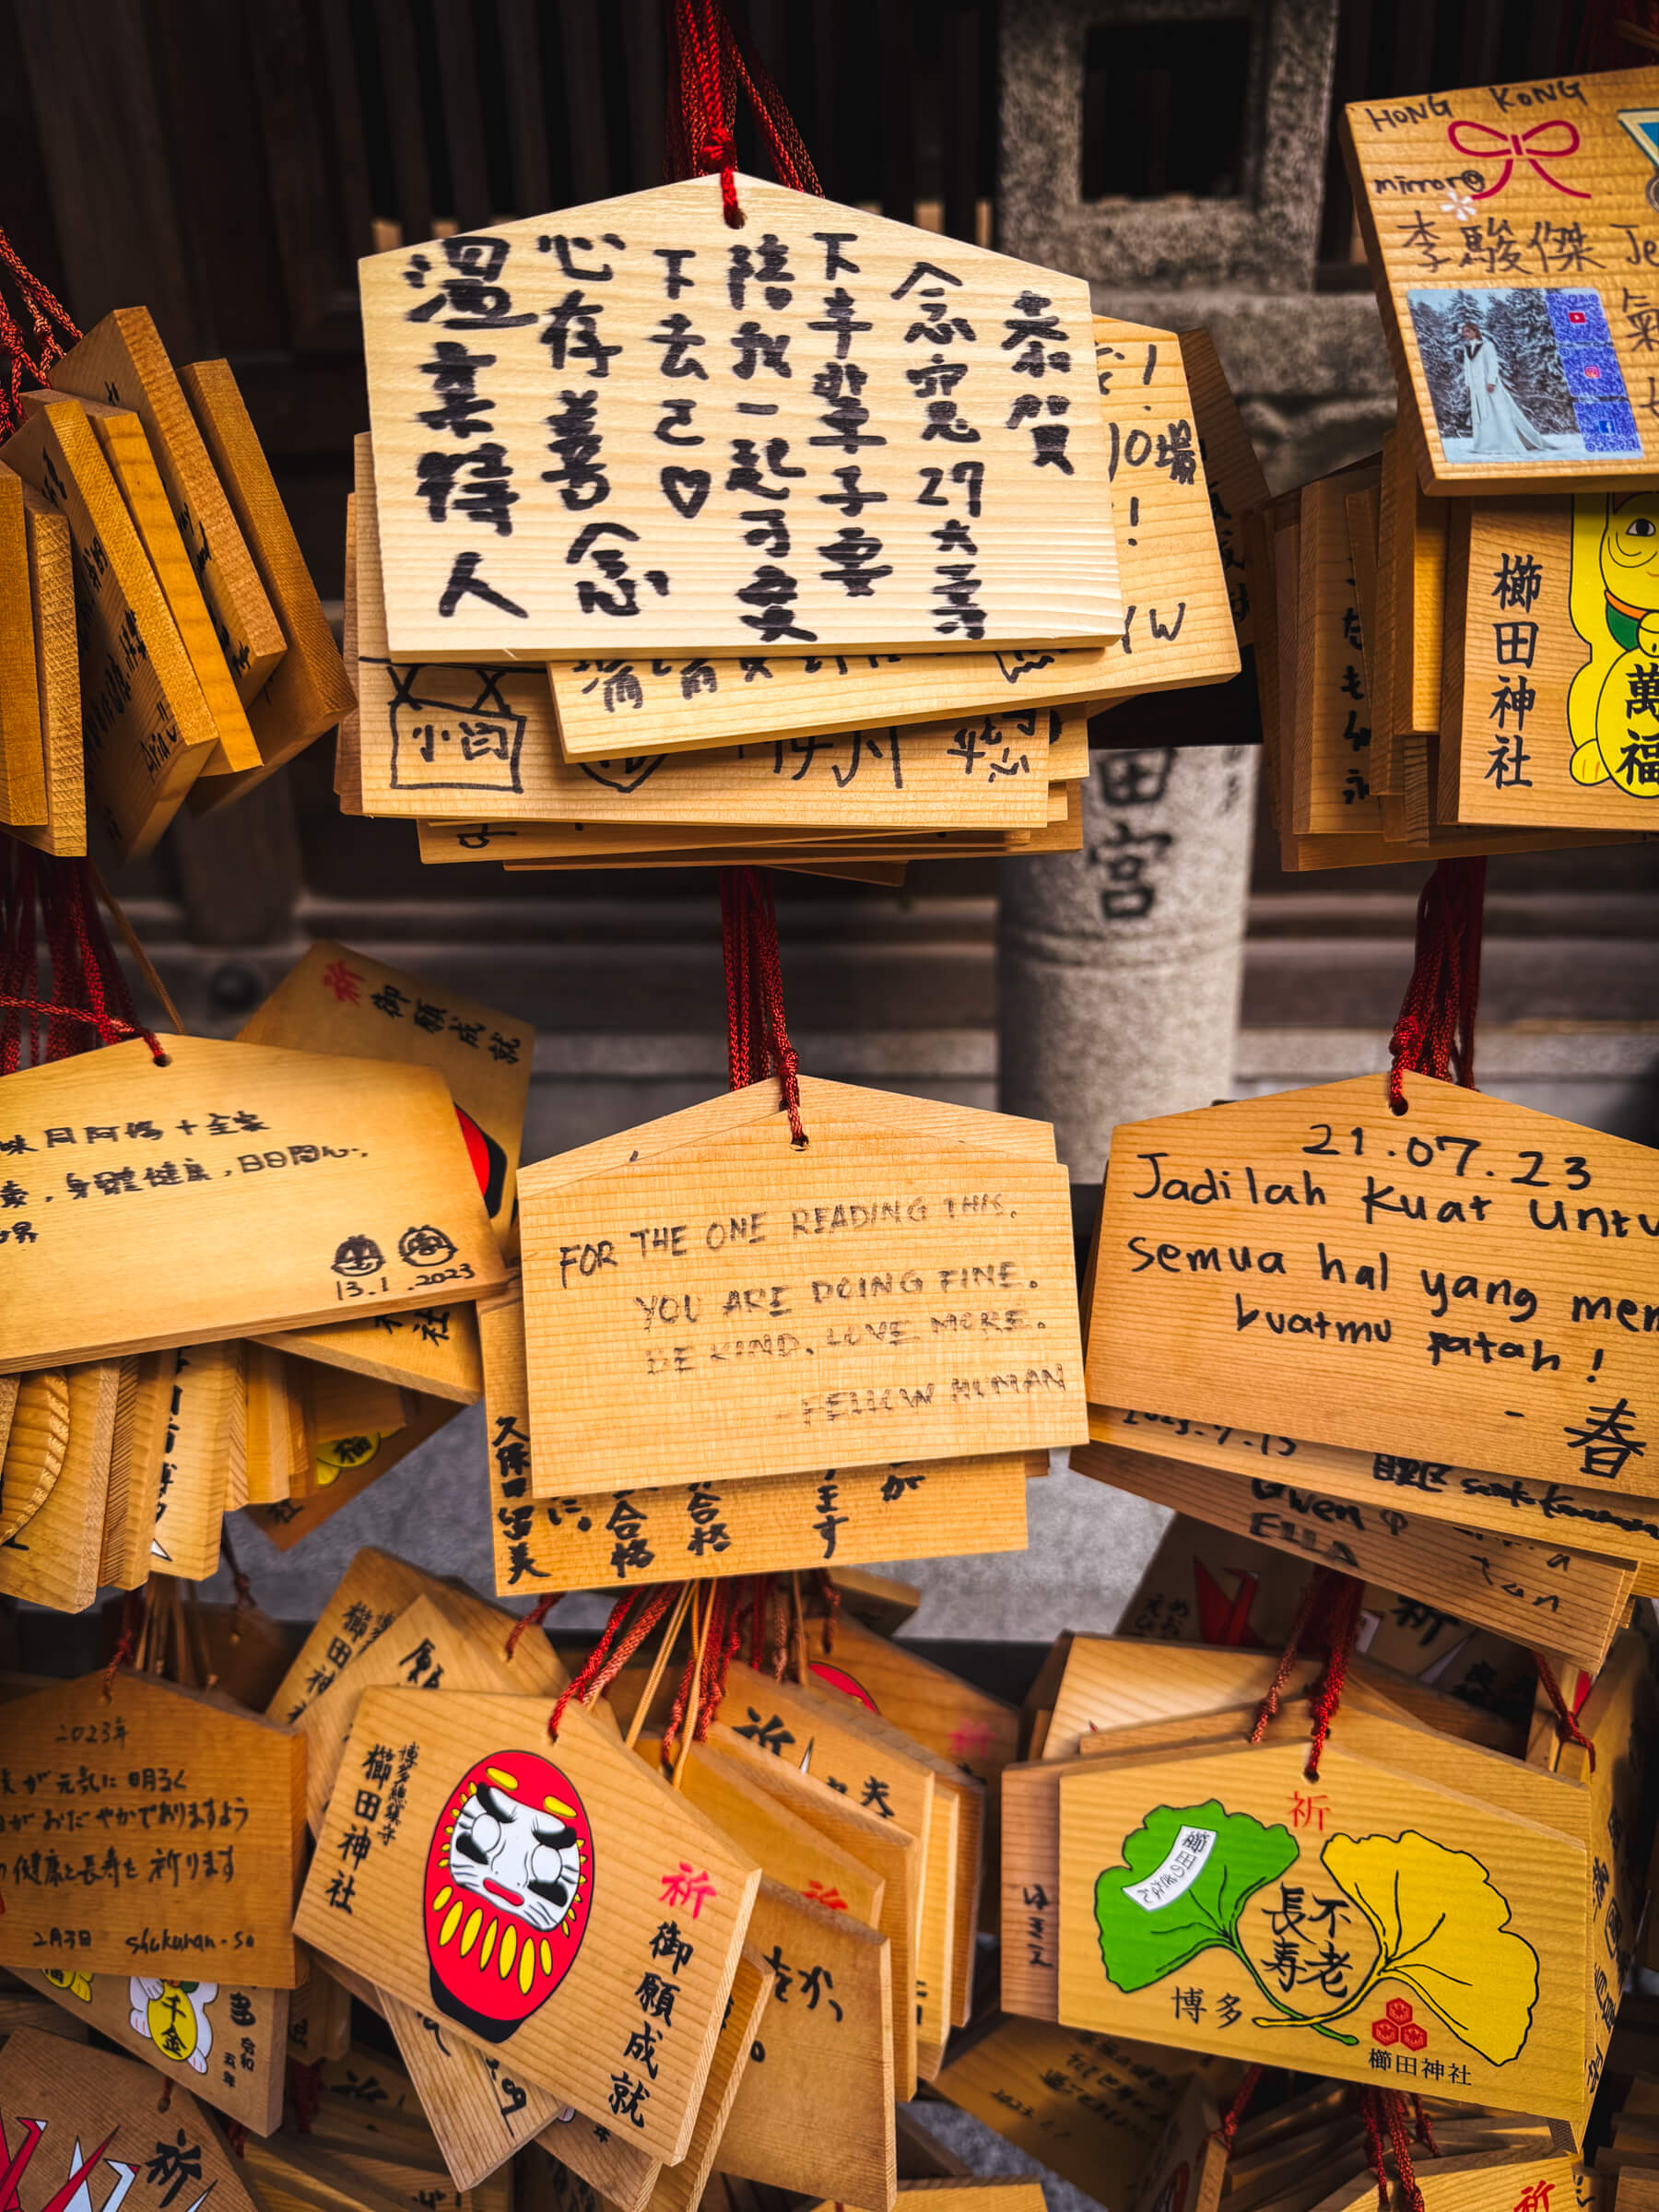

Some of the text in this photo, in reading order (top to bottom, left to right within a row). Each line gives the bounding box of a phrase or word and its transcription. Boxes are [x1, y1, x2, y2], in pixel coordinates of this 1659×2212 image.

[1002, 289, 1075, 475] 恭賀
[538, 233, 669, 617] 心存善念
[1484, 553, 1544, 790] 櫛田神社
[1300, 1122, 1593, 1191] 21.07.23
[560, 1240, 618, 1289] FOR
[630, 1224, 688, 1260] THE
[706, 1211, 767, 1251] ONE
[792, 1196, 927, 1239] READING
[1317, 1241, 1389, 1291] hal
[1420, 1268, 1538, 1323] yang
[634, 1293, 701, 1333] YOU
[723, 1285, 793, 1318] ARE
[811, 1268, 924, 1305] DOING
[1563, 1397, 1647, 1480] 春
[605, 1488, 659, 1579] 合格
[686, 1479, 732, 1557] 合格
[812, 1468, 851, 1559] ます
[324, 1743, 396, 1916] 櫛田神社
[1287, 1790, 1331, 1831] 祈
[657, 1862, 717, 1921] 祈
[1260, 1881, 1317, 1993] 長寿
[1296, 1893, 1354, 1999] 不老
[160, 1994, 188, 2059] 千金
[606, 1919, 694, 2129] 御願成就
[1171, 1985, 1243, 2030] 博多
[1367, 2048, 1473, 2088] 櫛田神社
[144, 2127, 203, 2209] 祈
